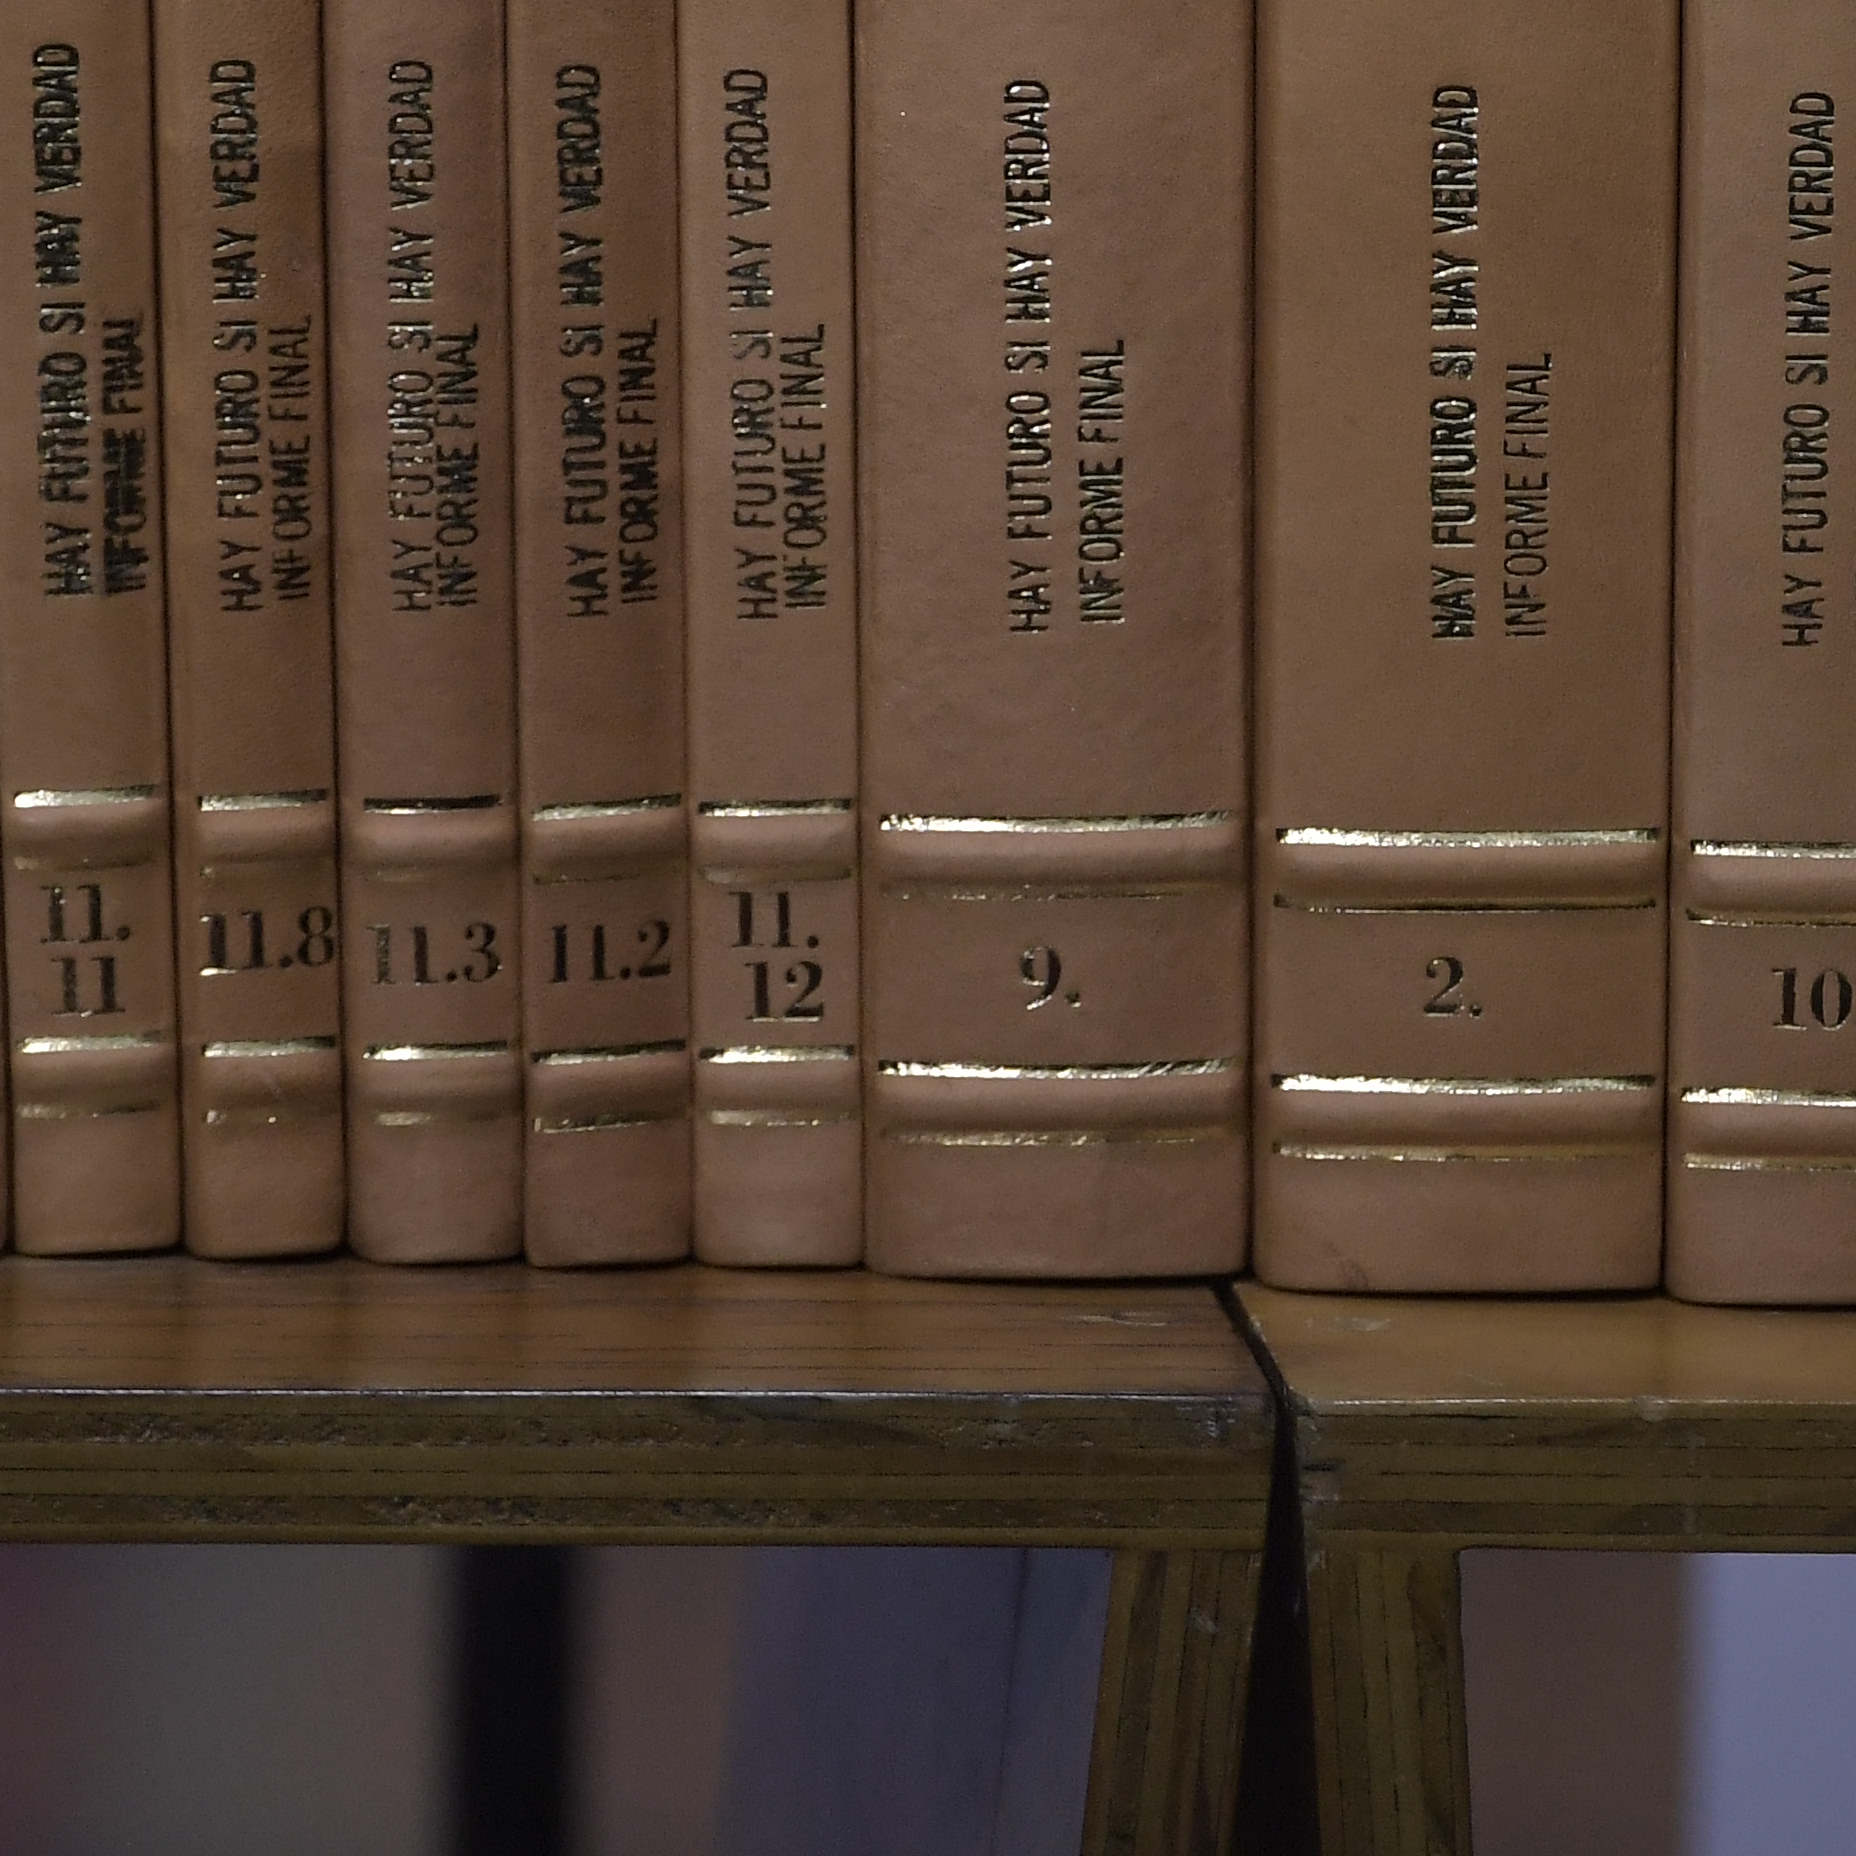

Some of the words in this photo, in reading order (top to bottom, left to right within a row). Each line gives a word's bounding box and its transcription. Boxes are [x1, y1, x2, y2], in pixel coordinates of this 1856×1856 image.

[1003, 79, 1051, 231] VERDAD
[1789, 90, 1834, 240] VERDAD
[1006, 247, 1052, 323] HAY
[1785, 260, 1831, 336] HAY
[1006, 340, 1051, 373] SI
[1785, 354, 1829, 386] SI
[1079, 340, 1125, 447] FINAL
[1007, 389, 1052, 540] FUTURO
[1781, 402, 1829, 554] FUTURO
[1079, 457, 1126, 624] INFORME
[1009, 559, 1051, 634] HAY
[1782, 574, 1824, 647] HAY
[40, 883, 132, 944] 11.
[199, 905, 336, 976] 11.8
[727, 890, 820, 949] 11.
[366, 921, 502, 986] 11.3
[549, 919, 672, 985] 11.2
[1018, 944, 1084, 1011] 9.
[1422, 954, 1483, 1018] 2.
[51, 957, 125, 1019] 11
[743, 960, 824, 1023] 12
